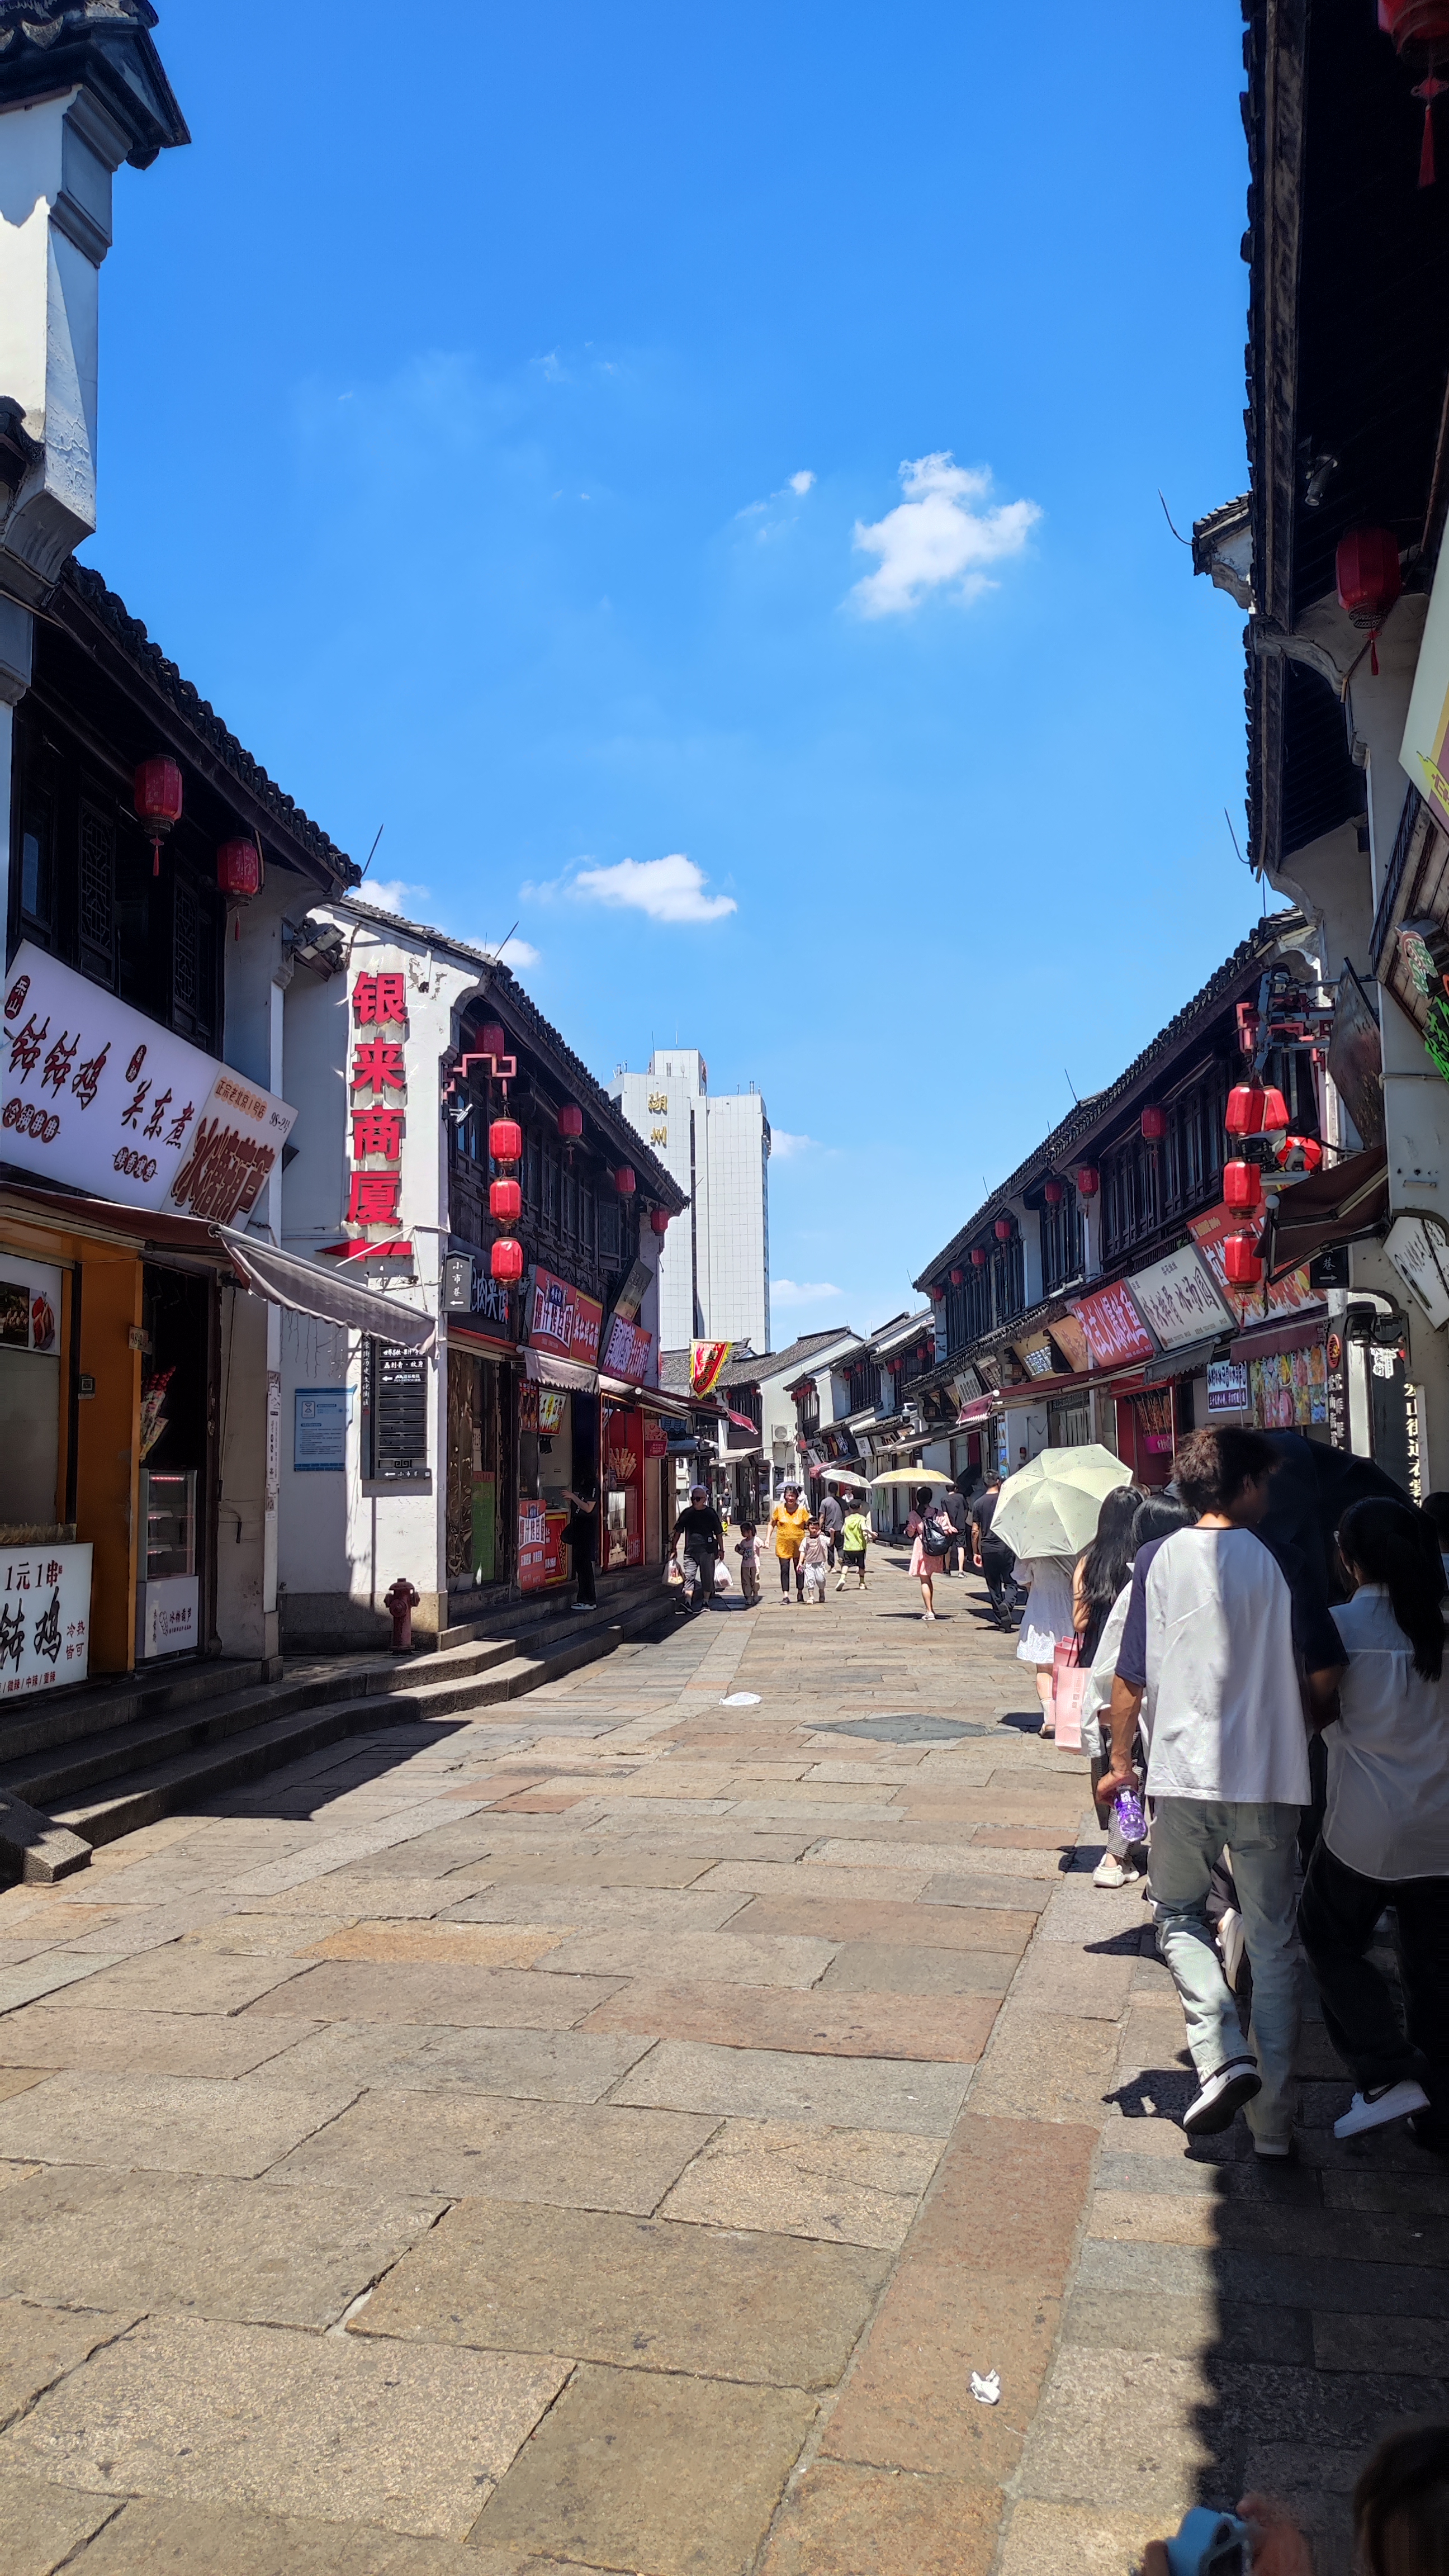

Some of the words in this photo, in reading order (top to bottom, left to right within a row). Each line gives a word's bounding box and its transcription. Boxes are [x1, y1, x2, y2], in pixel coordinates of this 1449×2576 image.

[7, 979, 27, 1015] 乐山
[9, 1013, 111, 1111] 钵钵鸡
[4, 1102, 58, 1139] 冷锅串串
[121, 1078, 195, 1149] 关东煮
[345, 971, 407, 1225] 银来商厦
[647, 1091, 667, 1148] 湖州
[171, 1117, 275, 1226] 冰糖葫芦
[452, 1261, 463, 1297] 小市巷
[1174, 1266, 1220, 1314] 冰汤圆
[1072, 1285, 1149, 1358] 花式火爆鱿鱼
[66, 1642, 84, 1660] 皆可
[67, 1621, 85, 1638] 冷热
